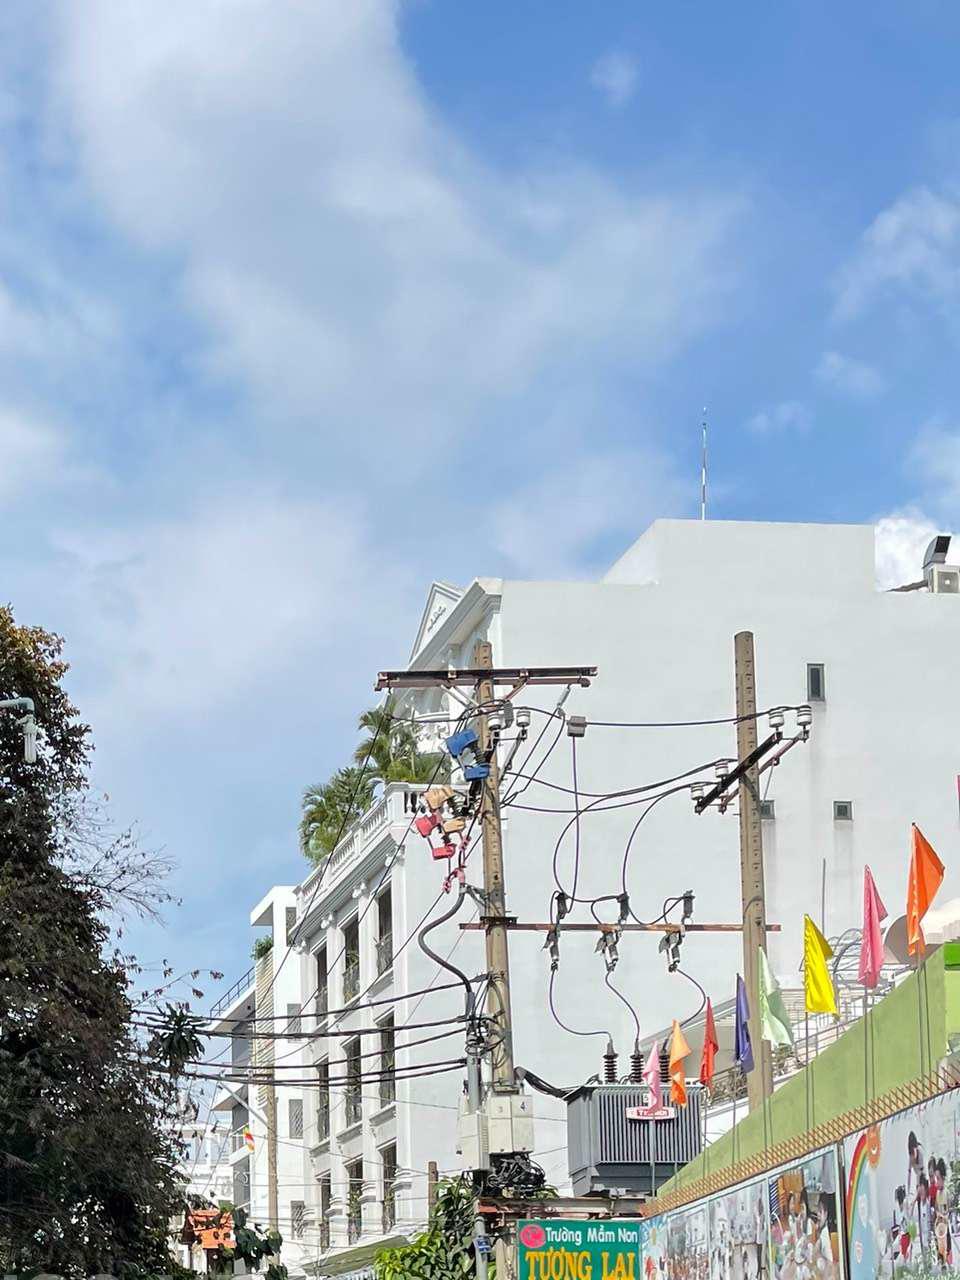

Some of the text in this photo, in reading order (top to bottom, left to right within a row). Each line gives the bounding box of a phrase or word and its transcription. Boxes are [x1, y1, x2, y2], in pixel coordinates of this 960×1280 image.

[545, 1226, 582, 1246] Trường
[618, 1227, 637, 1243] Non
[525, 1246, 636, 1280] TƯƠNG LAI
